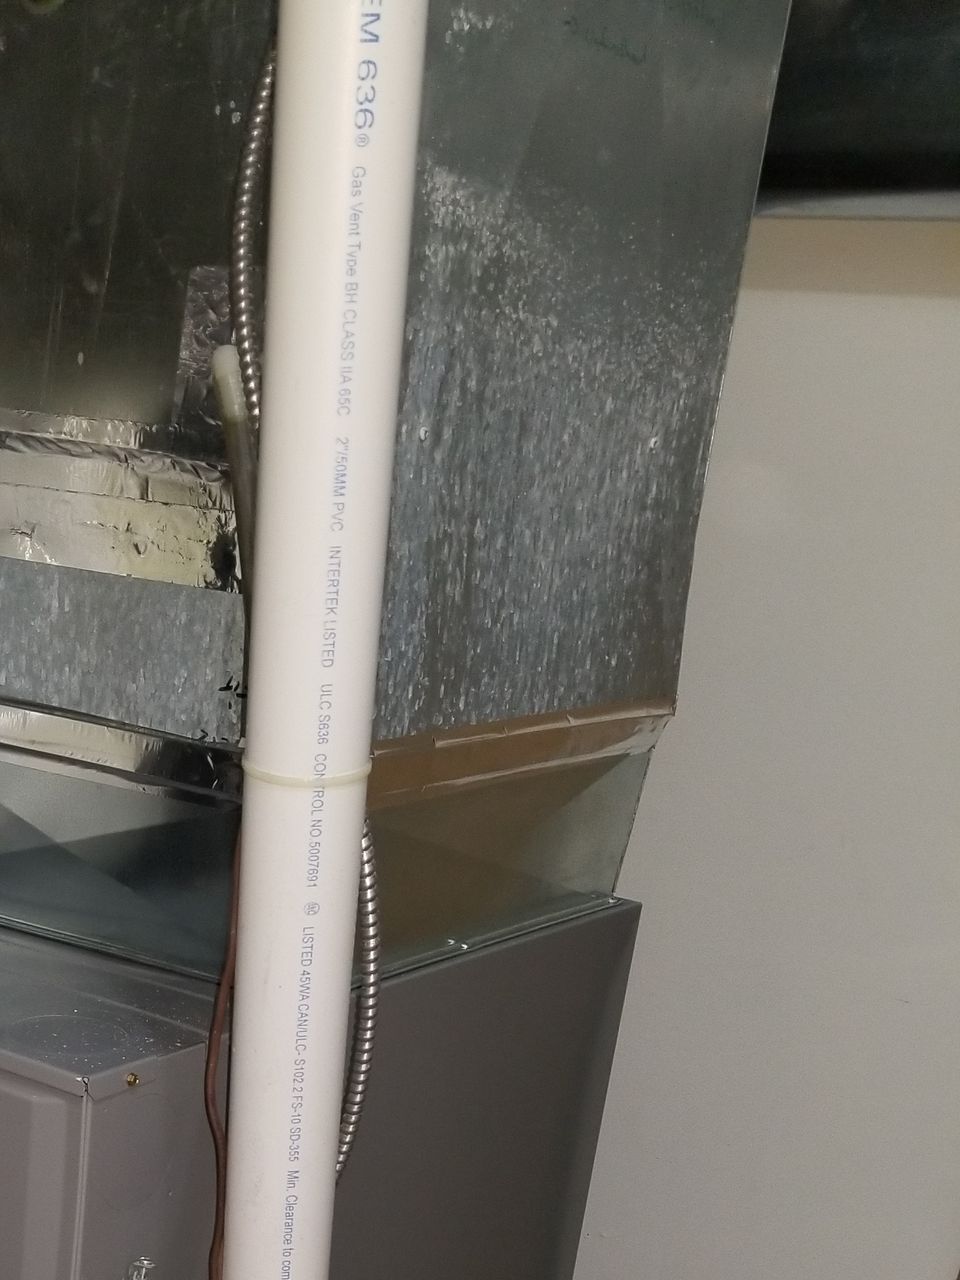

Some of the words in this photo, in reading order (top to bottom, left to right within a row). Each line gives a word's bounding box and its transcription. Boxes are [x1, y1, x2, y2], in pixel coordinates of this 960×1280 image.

[360, 0, 382, 43] M
[350, 165, 367, 197] Gas
[347, 202, 364, 236] Vent
[344, 241, 361, 277] Type
[343, 281, 359, 304] BH
[340, 309, 357, 361] CLASS
[338, 366, 353, 384] IIA
[336, 388, 351, 417] 65C
[330, 501, 345, 532] PVC
[325, 545, 342, 616] INTERTEK
[321, 620, 336, 668] LISTED
[319, 683, 333, 710] ULC
[317, 714, 330, 745] S636
[300, 926, 315, 967] LISTED
[298, 970, 311, 1002] 45WA
[292, 1058, 306, 1093] S102.2
[290, 1095, 304, 1125] FS-10
[288, 1127, 302, 1162] SD-355
[286, 1170, 300, 1192] Min.
[283, 1195, 298, 1245] Clearance
[282, 1248, 295, 1258] to
